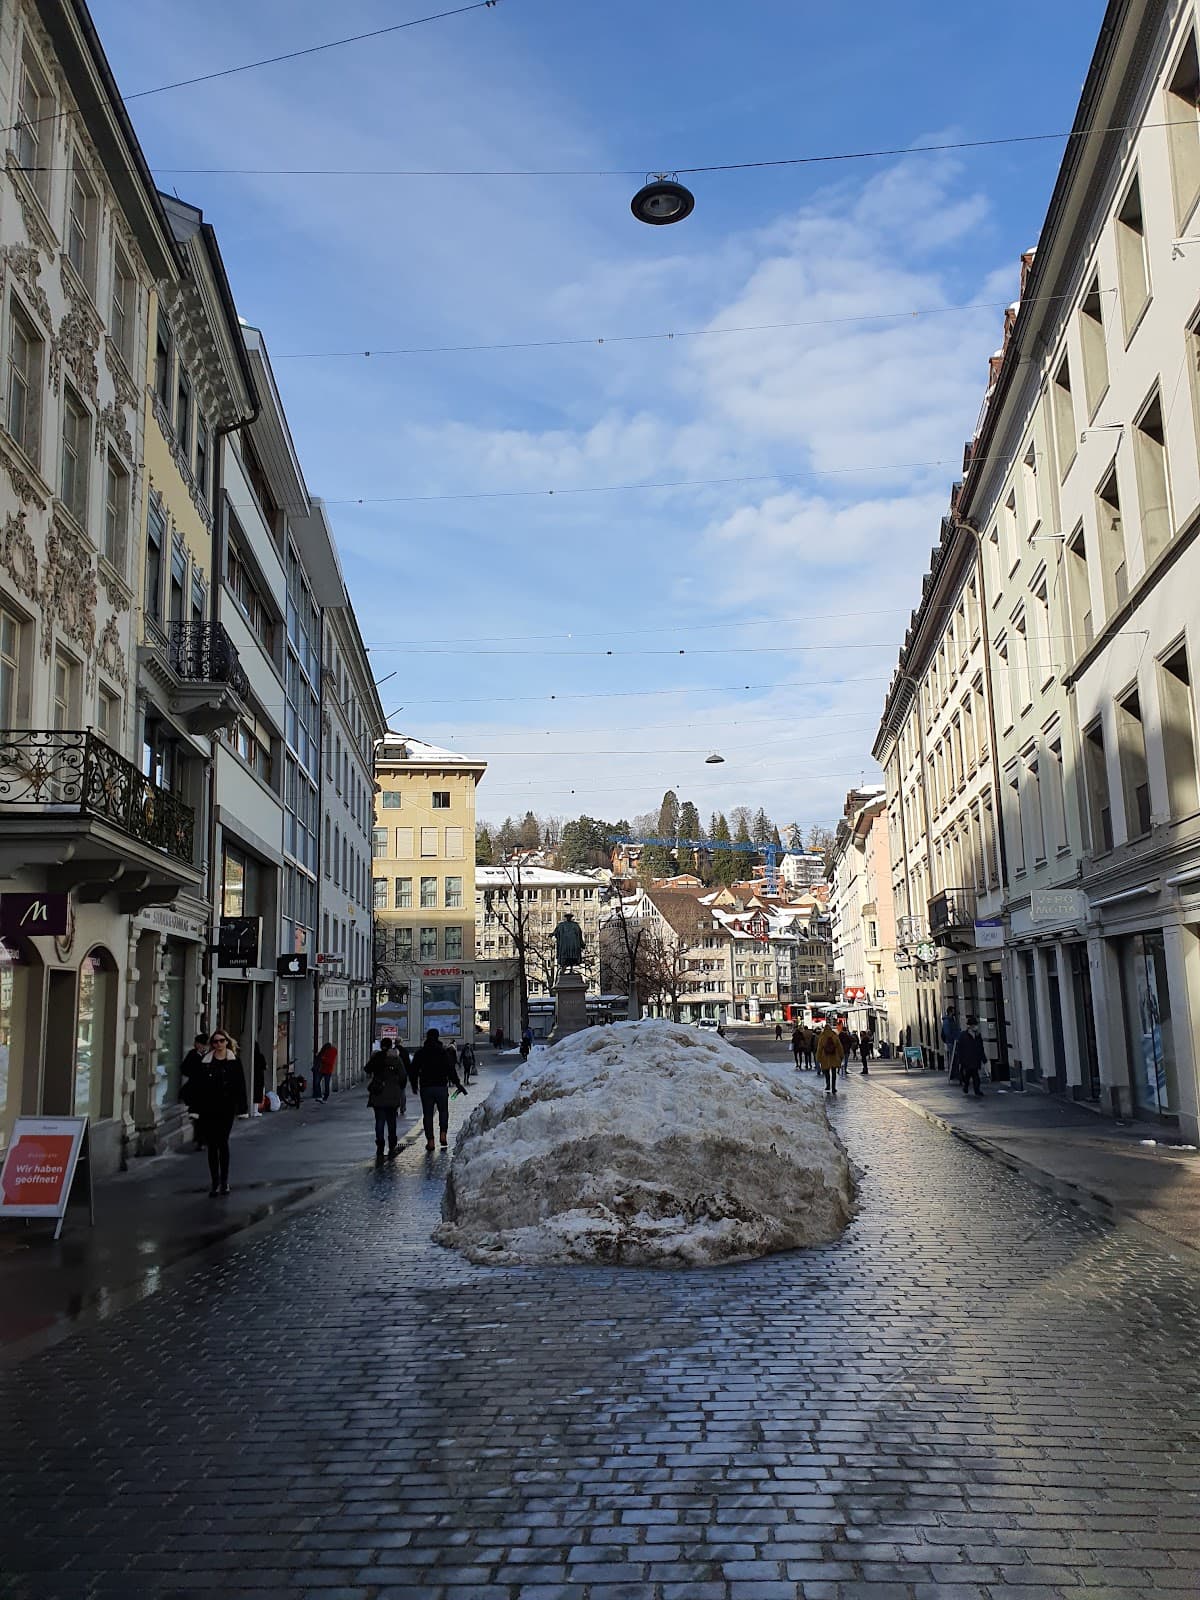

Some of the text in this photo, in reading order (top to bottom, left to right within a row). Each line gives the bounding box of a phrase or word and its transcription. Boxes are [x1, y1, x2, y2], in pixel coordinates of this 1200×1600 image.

[16, 1164, 63, 1173] Wir haben
[15, 1174, 58, 1185] geöffnet!
